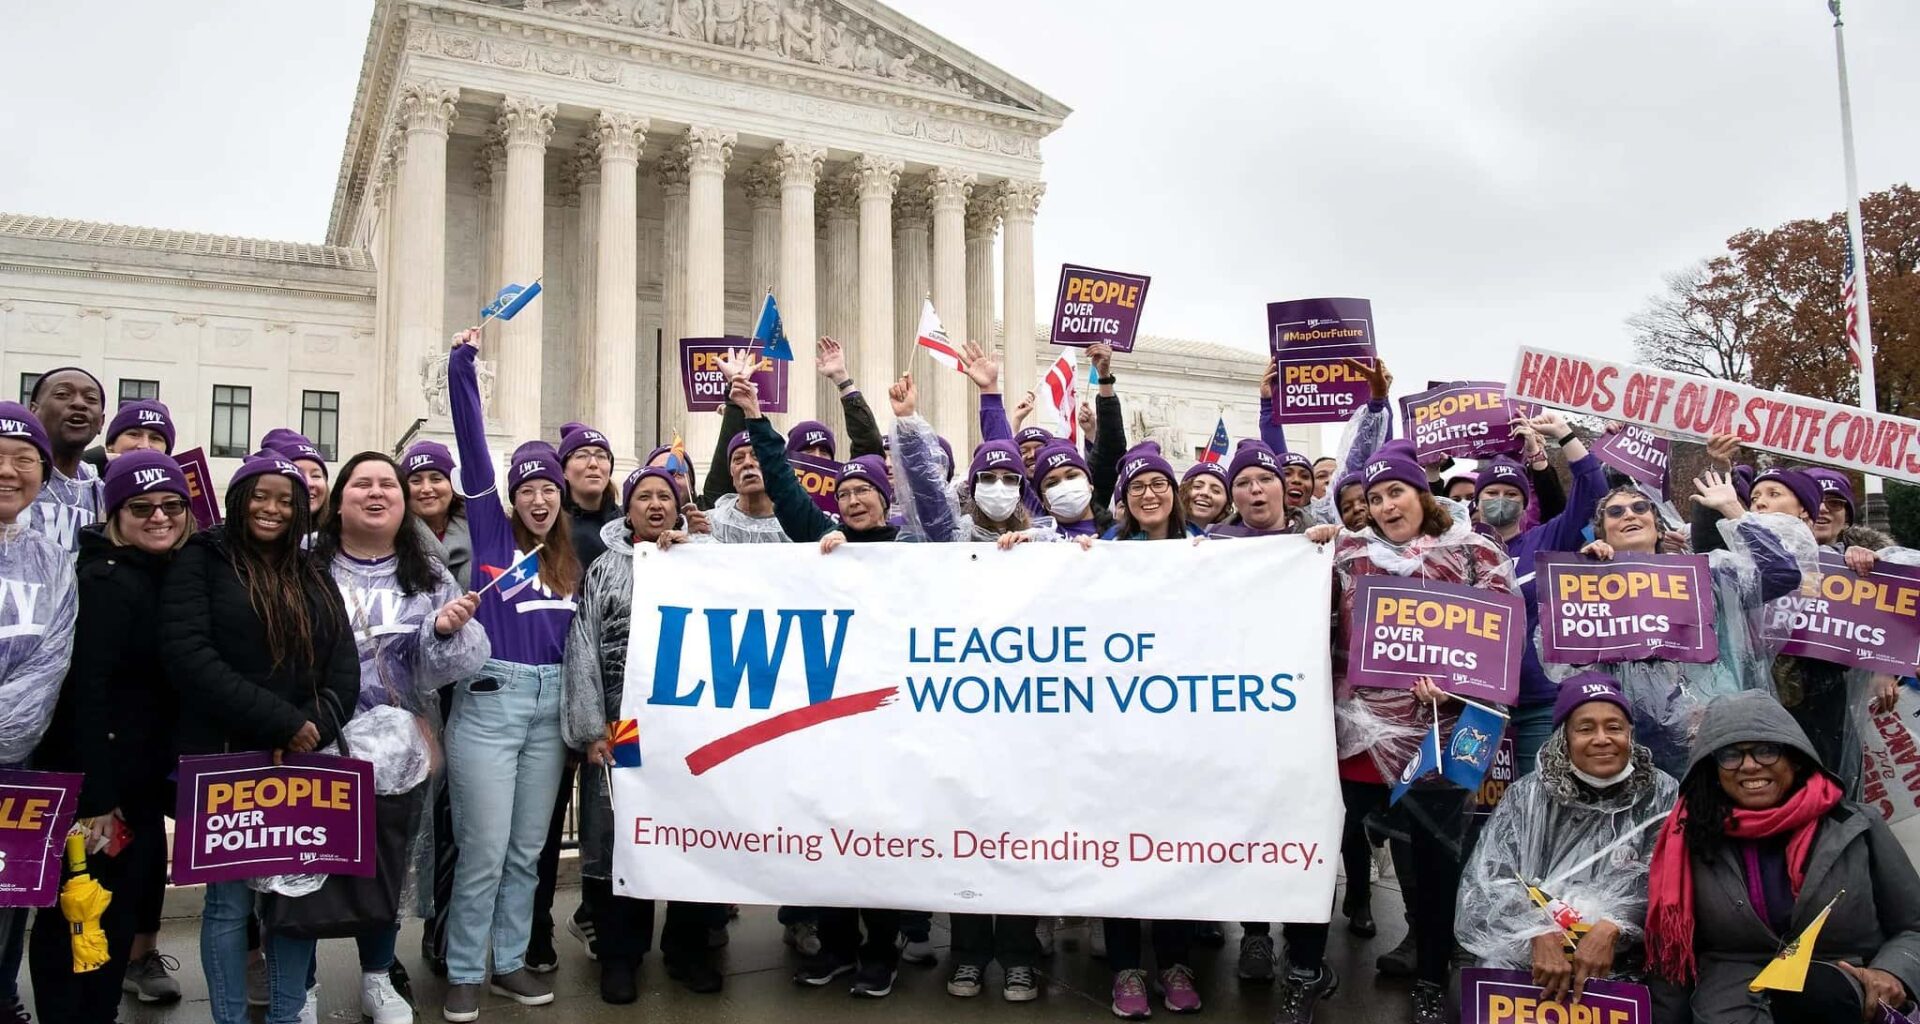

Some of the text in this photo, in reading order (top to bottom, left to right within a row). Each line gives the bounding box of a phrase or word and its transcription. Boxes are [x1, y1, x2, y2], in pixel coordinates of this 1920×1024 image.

[1066, 277, 1139, 309] PEOPLE
[1064, 302, 1094, 316] OVER
[1061, 316, 1120, 335] POLITICS
[1283, 328, 1364, 342] #MapOurFuture
[694, 372, 723, 382] OVER
[1286, 384, 1318, 394] OVER
[1286, 393, 1353, 408] POLITICS
[1415, 392, 1503, 425] PEOPLE
[1516, 351, 1619, 412] HANDS
[1622, 372, 1676, 426] OFF
[1674, 381, 1741, 435] OUR
[1738, 396, 1828, 456] STATE
[139, 410, 163, 422] LWV
[1025, 429, 1041, 437] LWV
[1416, 417, 1448, 436] OVER
[1416, 421, 1489, 449] POLITICS
[806, 431, 824, 441] LWV
[1626, 426, 1655, 446] OVER
[409, 454, 430, 466] LWV
[986, 451, 1007, 462] LWV
[1048, 454, 1067, 466] LWV
[1258, 452, 1275, 466] LWV
[519, 461, 540, 475] LWV
[843, 463, 863, 474] LWV
[1125, 458, 1145, 475] LWV
[1366, 461, 1386, 478] LWV
[1494, 465, 1513, 475] LWV
[133, 468, 164, 485] LWV
[1818, 479, 1835, 489] WV
[1559, 572, 1689, 601] PEOPLE
[338, 586, 405, 627] WV
[1562, 602, 1612, 617] OVER
[1776, 597, 1829, 614] OVER
[1375, 597, 1501, 641] PEOPLE
[1562, 614, 1670, 637] POLITICS
[1374, 625, 1424, 642] OVER
[1772, 611, 1886, 646] POLITICS
[908, 626, 1156, 663] LEAGUE OF
[1647, 638, 1662, 646] LWV
[647, 605, 855, 710] LWV
[1372, 641, 1477, 670] POLITICS
[1452, 673, 1467, 682] LWV
[906, 676, 1093, 713] WOMEN
[1582, 684, 1611, 694] LWV
[207, 777, 351, 814] PEOPLE
[206, 810, 265, 831] OVER
[205, 825, 327, 854] POLITICS
[634, 817, 1324, 870] Empowering Voters. Defending Democracy.
[300, 852, 316, 860] LWV
